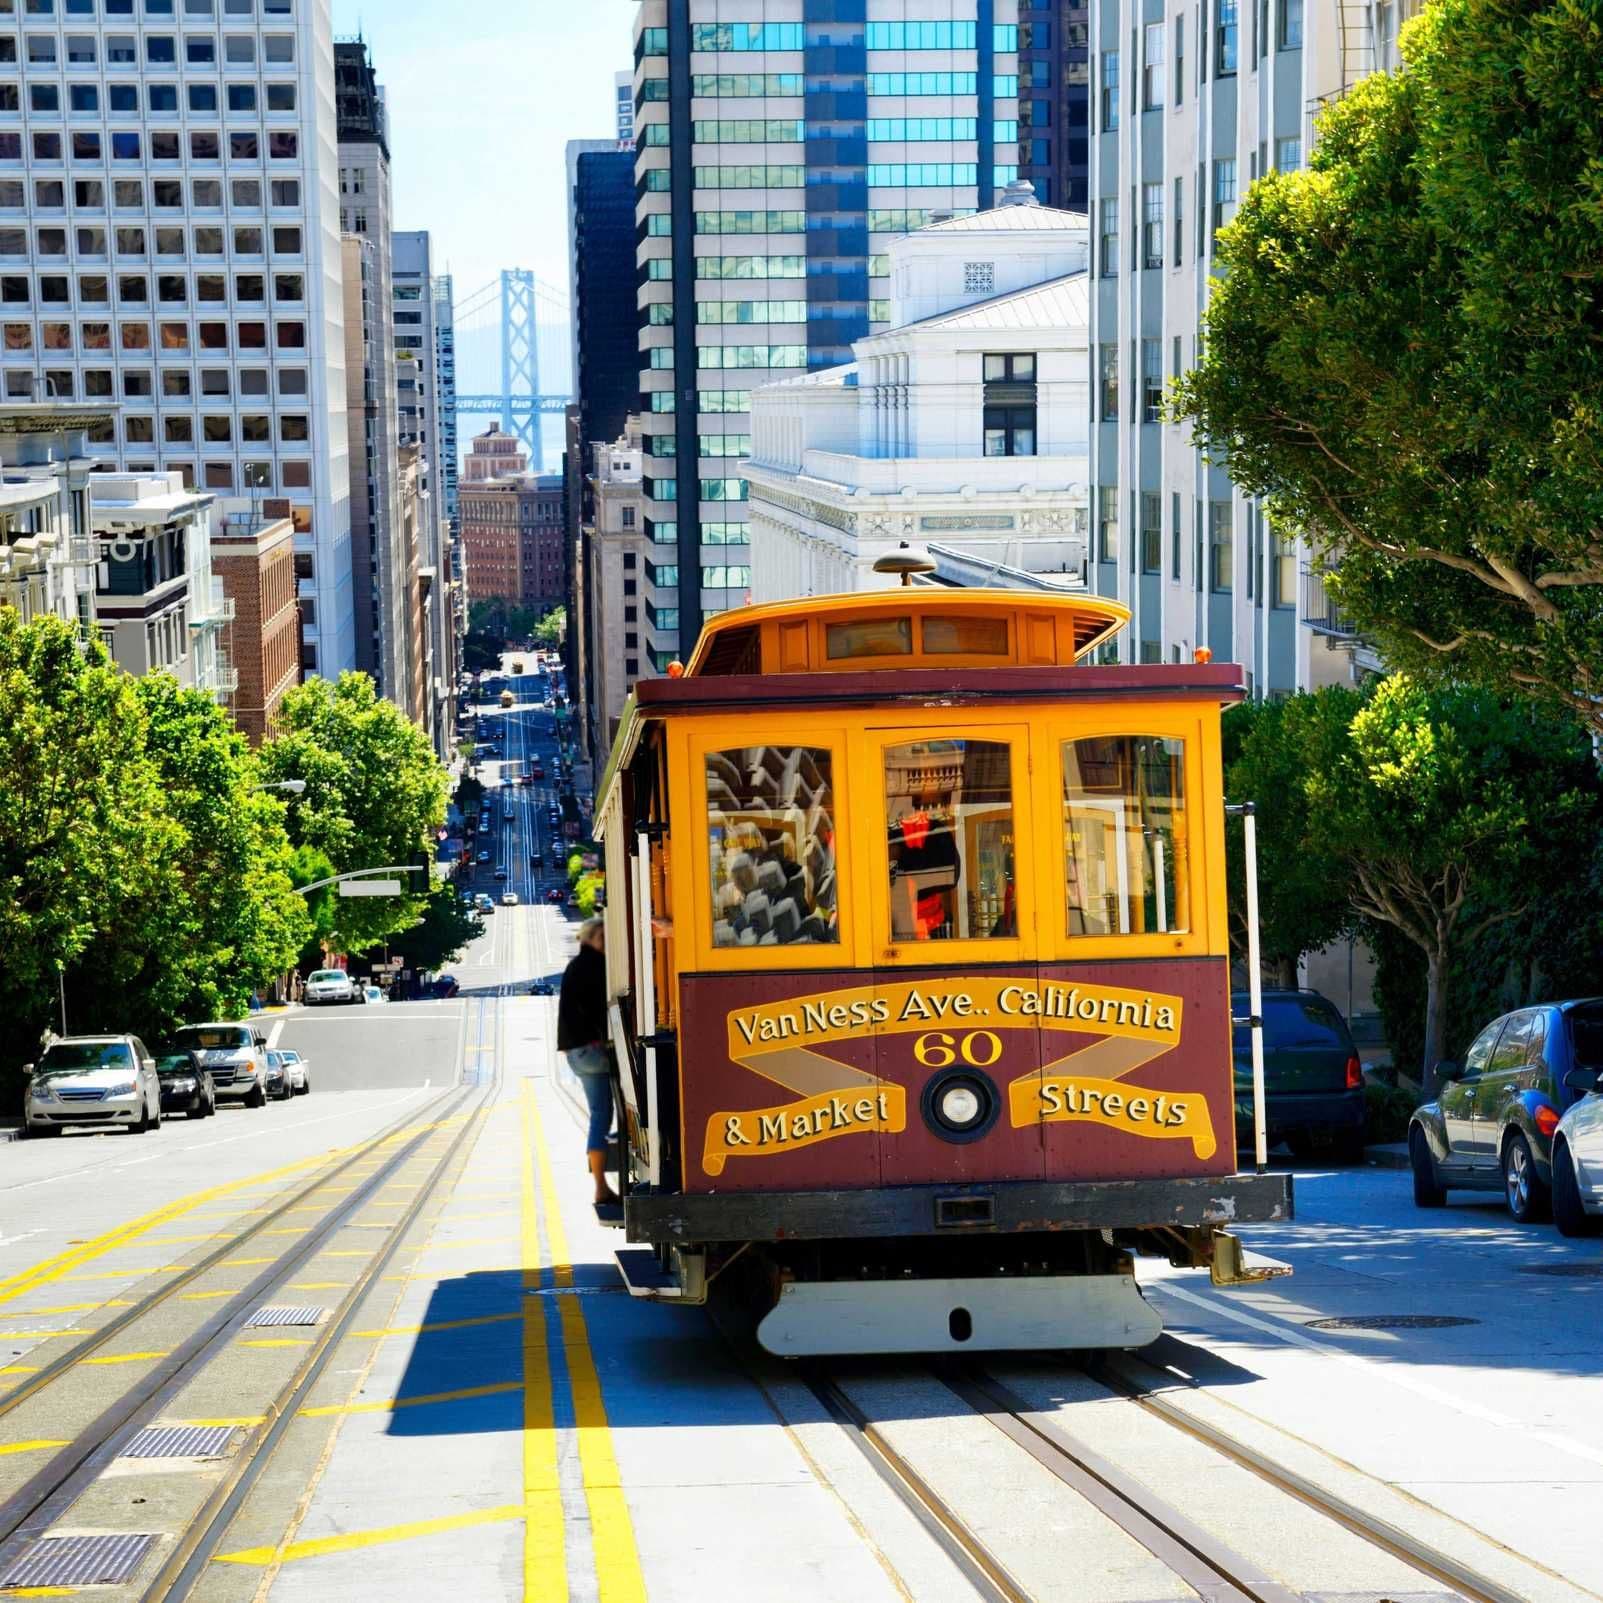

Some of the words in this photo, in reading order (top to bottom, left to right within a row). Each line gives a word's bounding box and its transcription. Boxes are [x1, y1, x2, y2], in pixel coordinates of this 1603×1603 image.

[736, 1013, 799, 1045] Van
[800, 999, 890, 1033] Ness
[998, 985, 1176, 1031] California
[914, 1031, 1003, 1067] 60
[725, 1116, 752, 1146] &
[757, 1092, 889, 1145] Market
[1039, 1083, 1188, 1128] Streets
